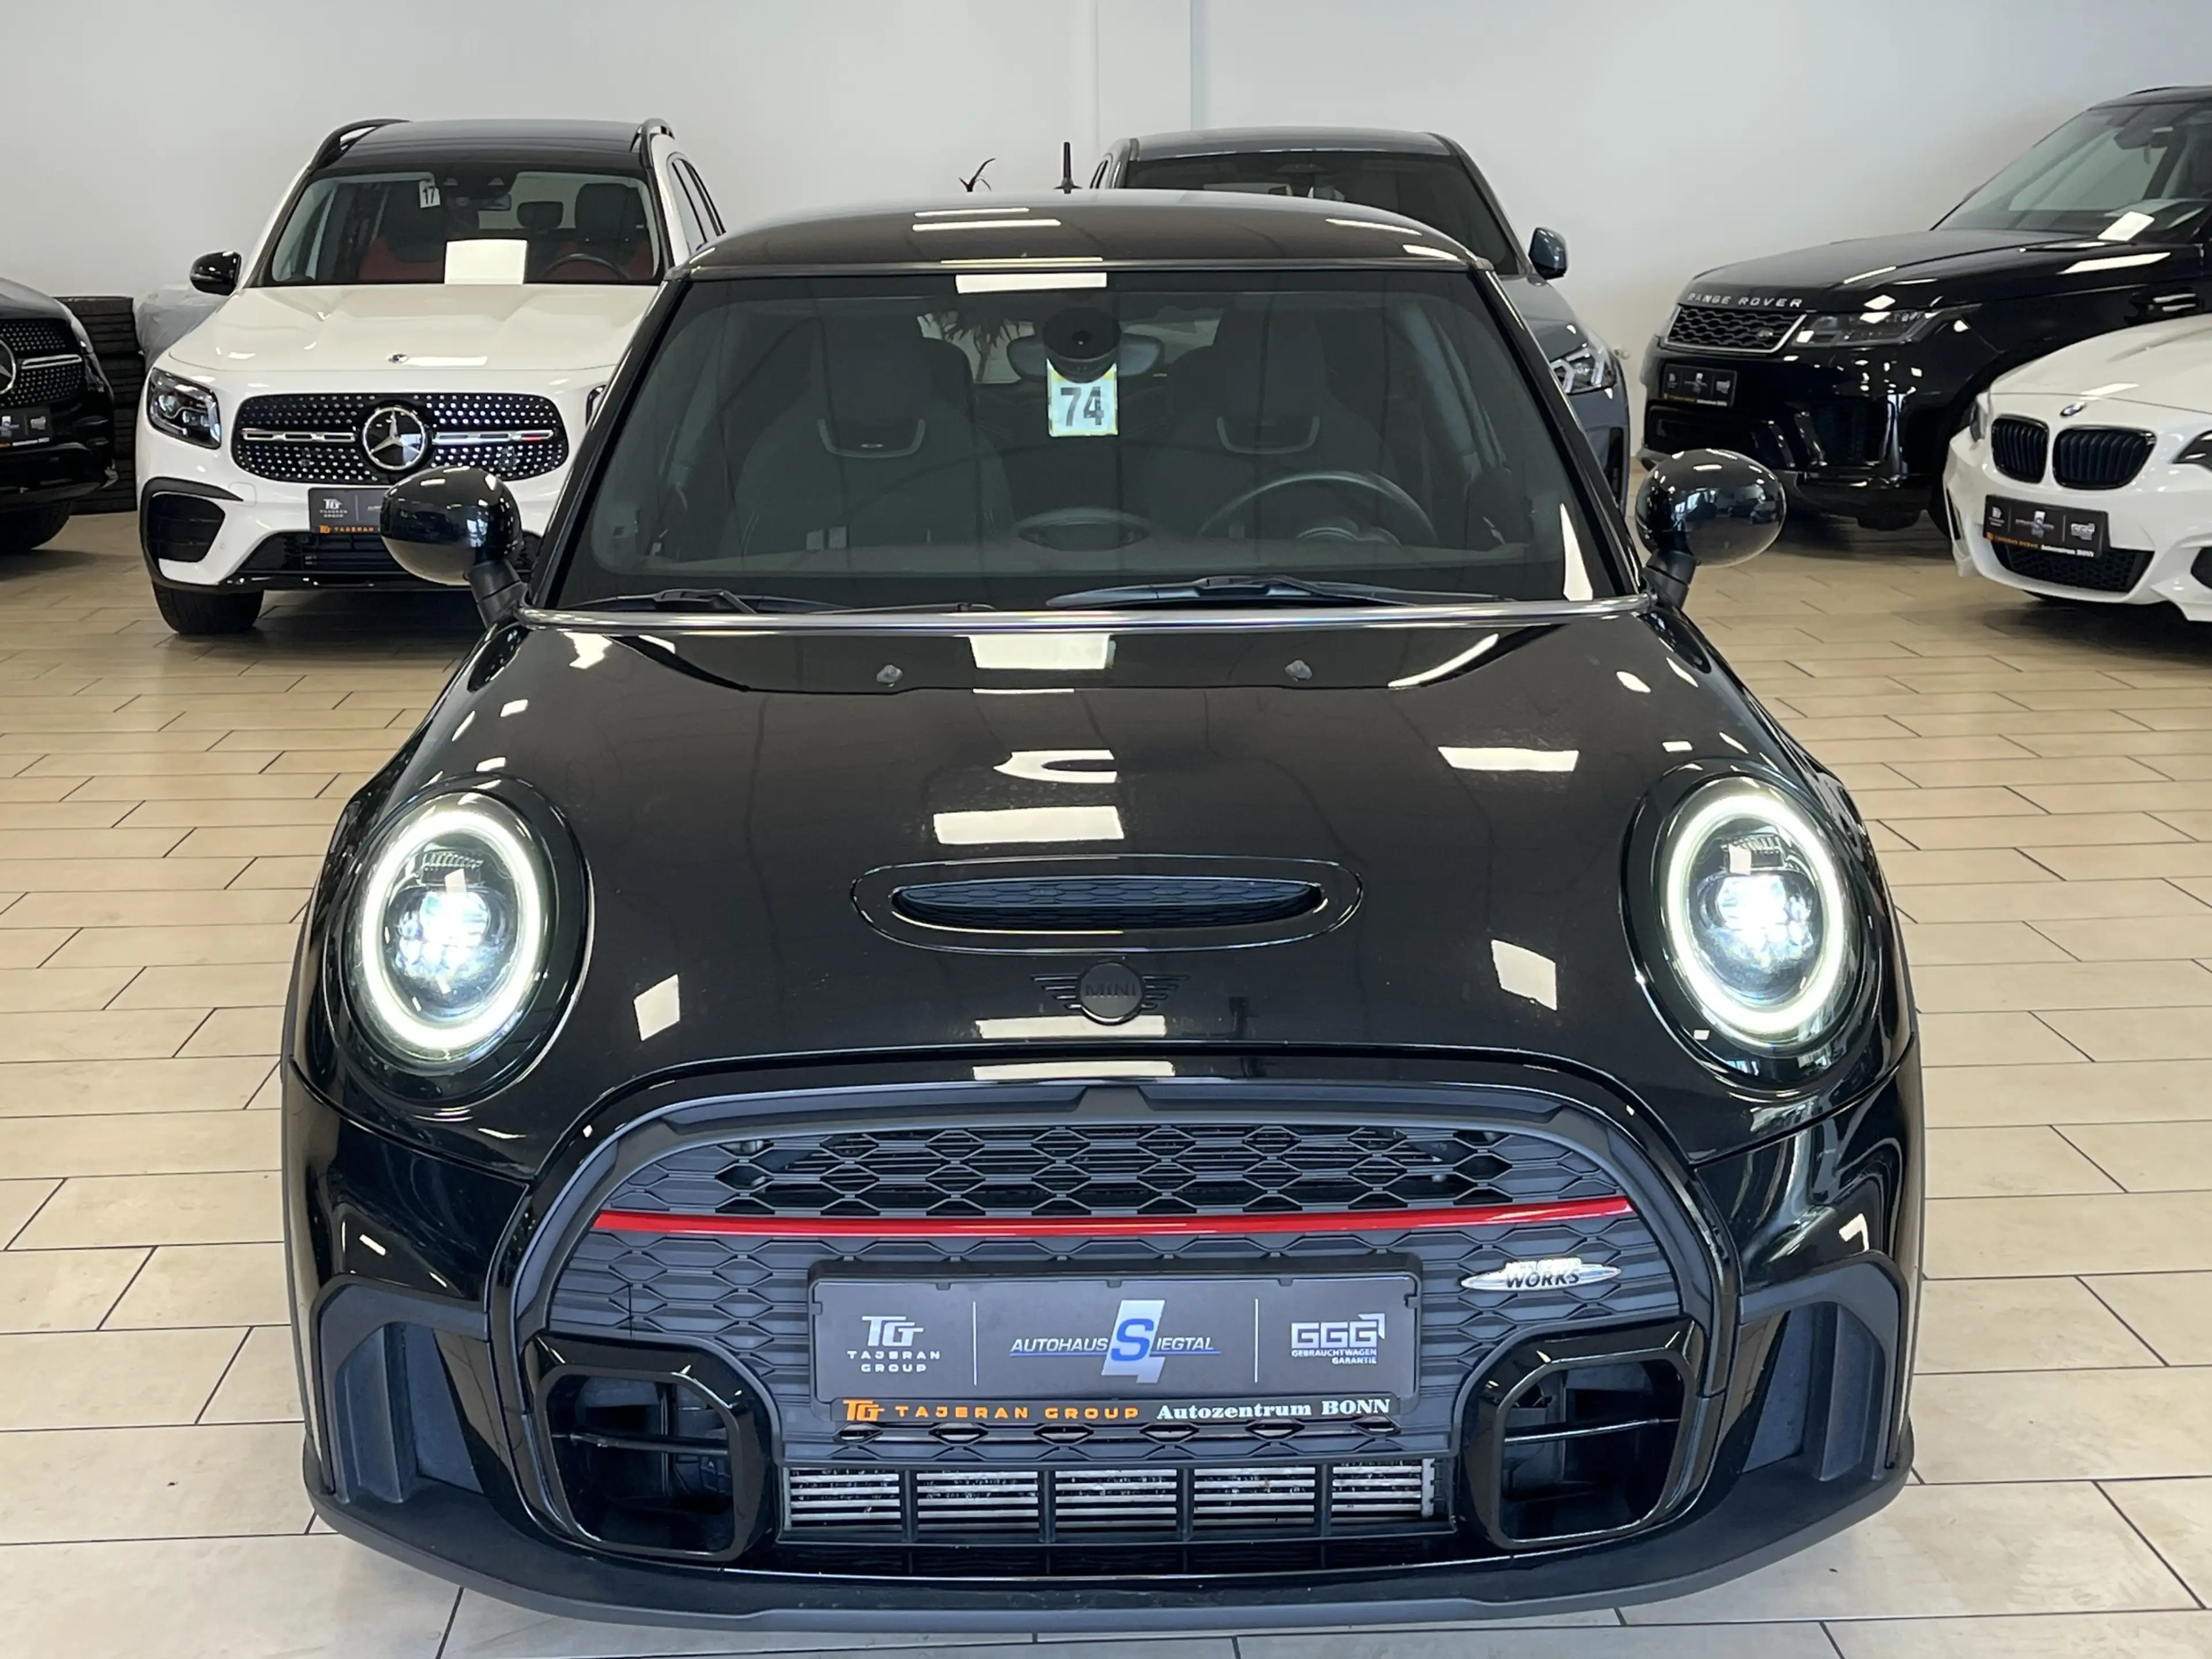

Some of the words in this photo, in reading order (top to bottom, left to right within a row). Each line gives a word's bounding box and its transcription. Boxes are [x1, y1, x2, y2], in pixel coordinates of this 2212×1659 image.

[422, 186, 436, 205] 17
[1687, 293, 1731, 304] RANGE
[1738, 297, 1802, 308] ROVER
[1060, 386, 1104, 426] 74
[1085, 981, 1137, 998] MINI
[1506, 1270, 1580, 1289] WORKS
[1291, 1321, 1377, 1349] GGG
[1010, 1338, 1108, 1353] AUTOHAUS
[1291, 1349, 1377, 1358] GEBRAUCHTWAGEN
[847, 1350, 940, 1360] TAJERAN
[1331, 1357, 1377, 1365] GARANTIE
[861, 1363, 927, 1373] GROUP
[895, 1405, 1028, 1419] TAJERAN
[1044, 1406, 1139, 1420] GROUP
[1156, 1402, 1312, 1420] Autozentrum
[1321, 1398, 1391, 1415] BONN
